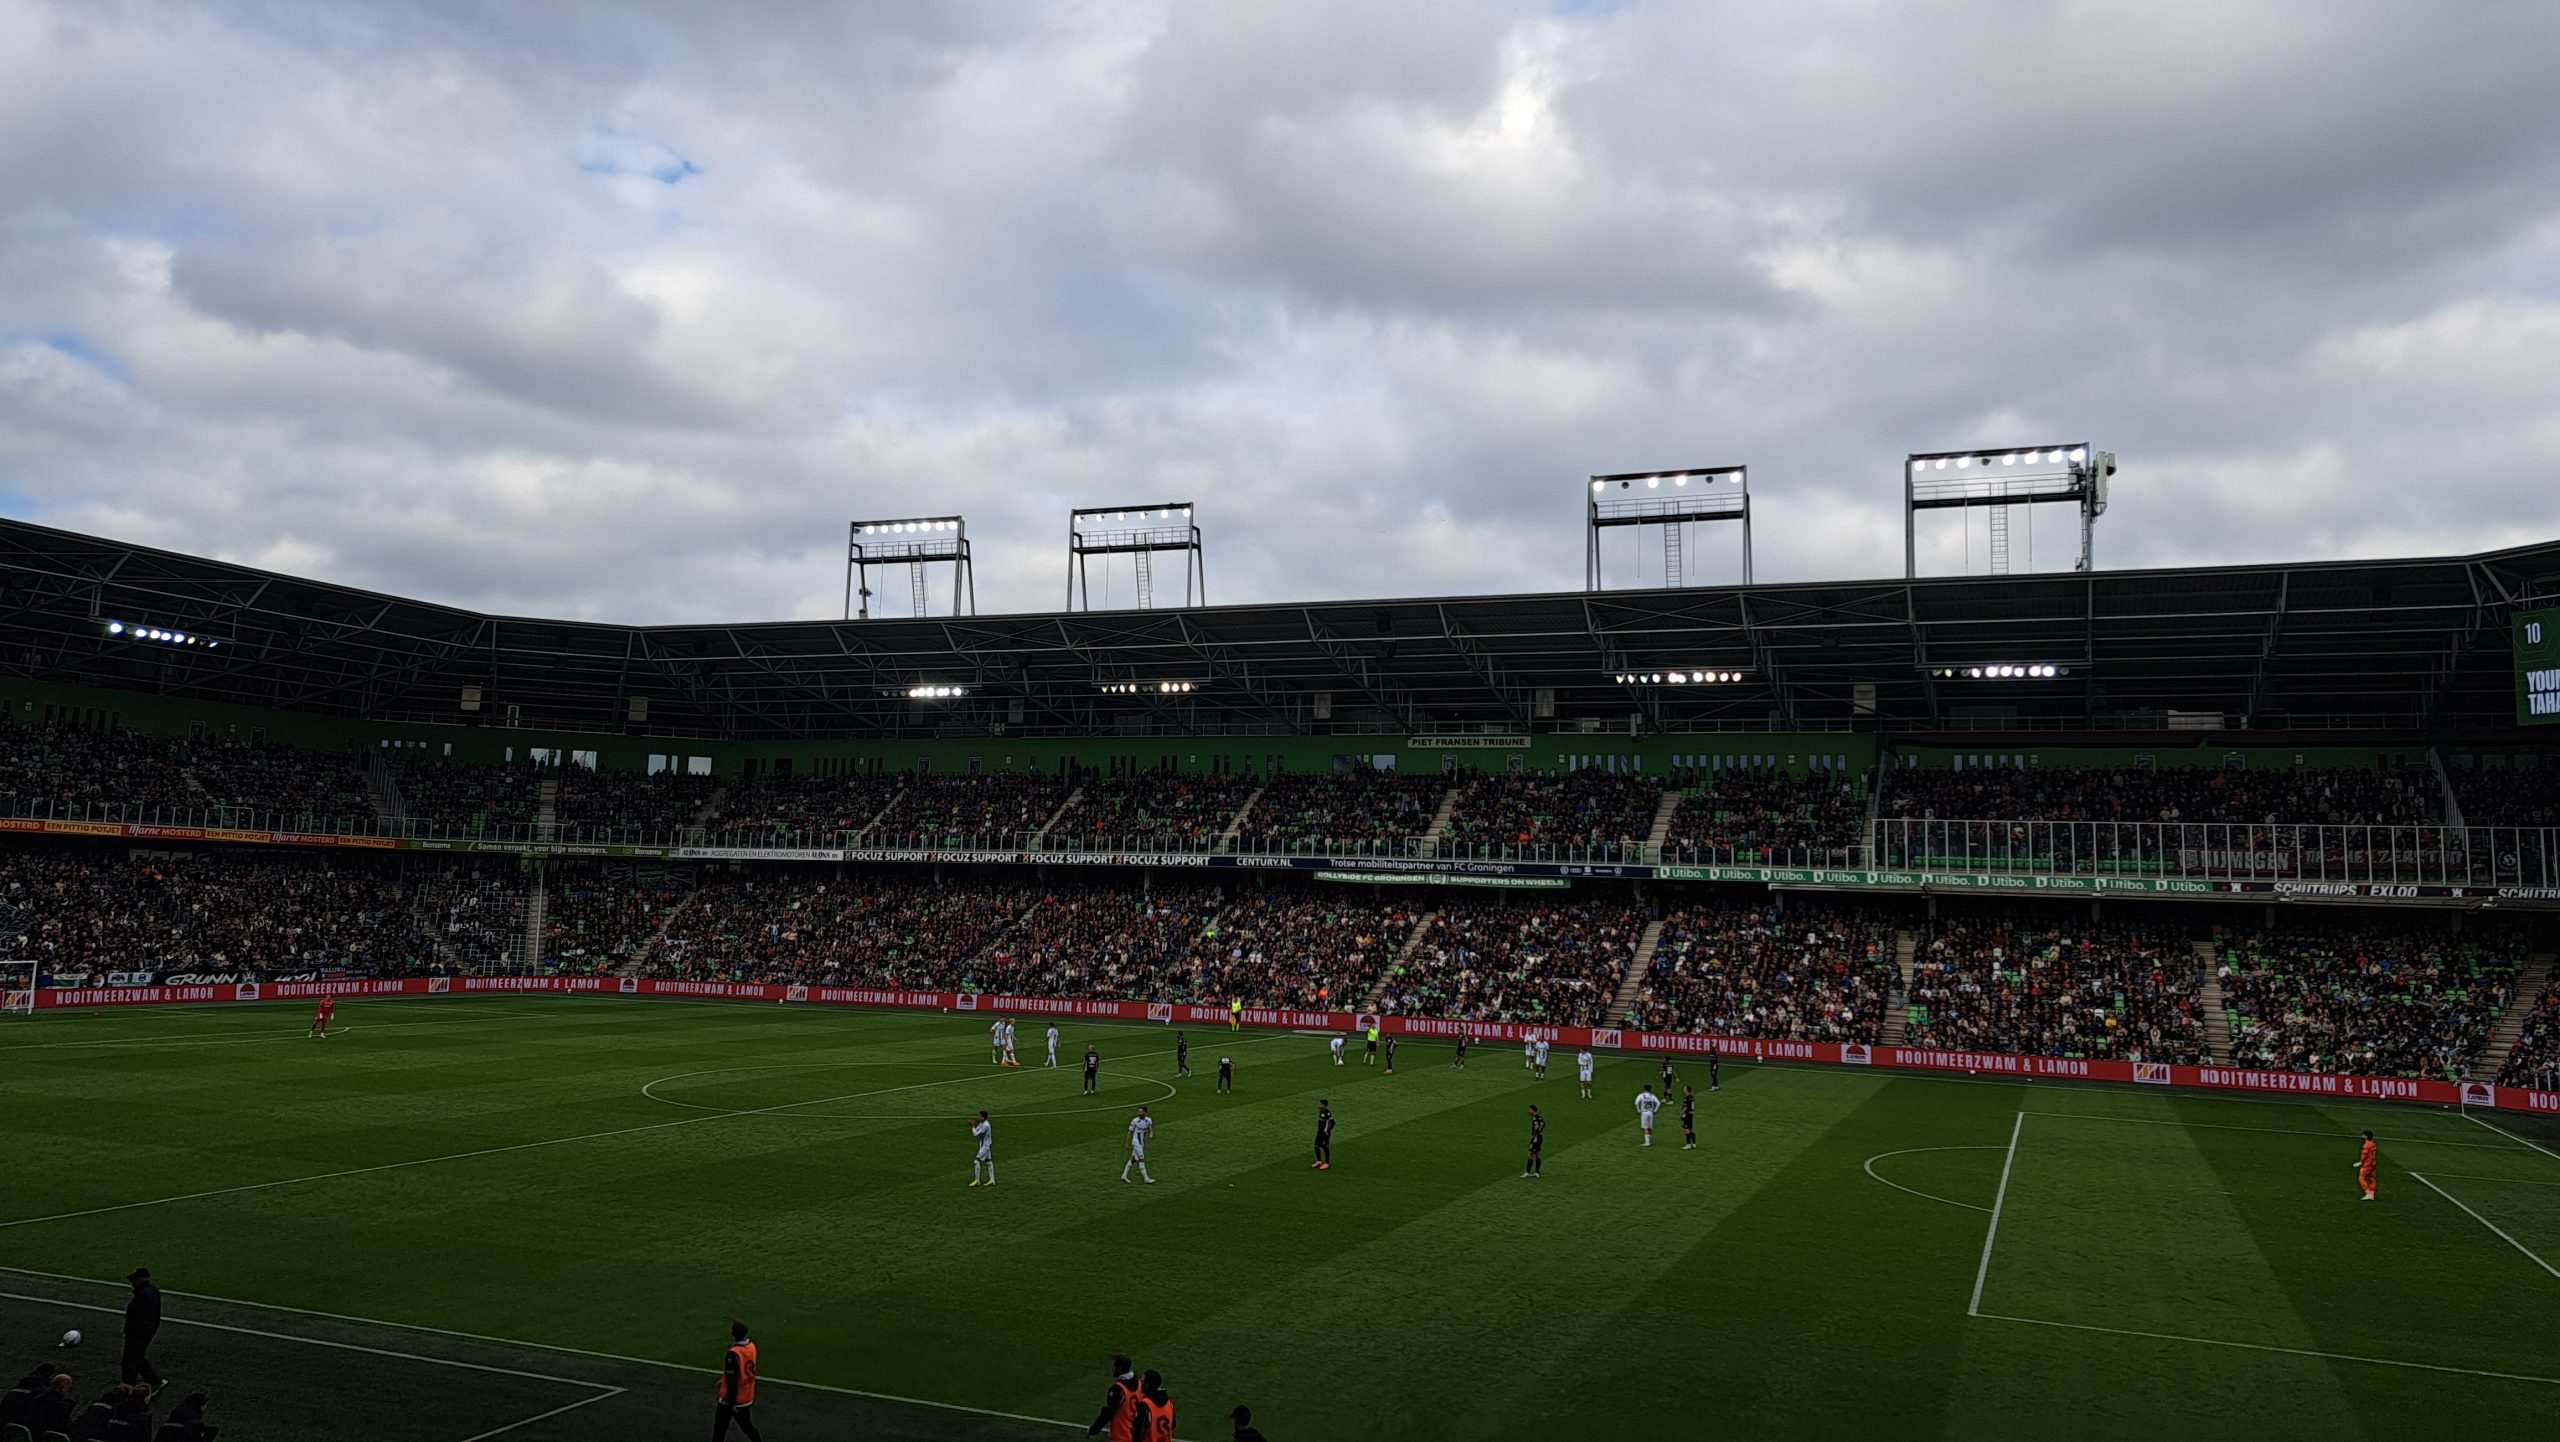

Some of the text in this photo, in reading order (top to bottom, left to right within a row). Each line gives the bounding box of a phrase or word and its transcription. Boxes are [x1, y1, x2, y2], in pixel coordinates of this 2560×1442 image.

[2524, 623, 2541, 644] 10
[128, 825, 202, 837] Marne MOSTERD
[300, 836, 335, 844] MOSTERD
[851, 851, 930, 862] FOCUZ SUPPORT
[937, 852, 1017, 863] FOCUZ SUPPORT
[1030, 853, 1113, 865] FOCUZ SUPPORT
[1123, 855, 1210, 866] FOCUZ SUPPORT
[1236, 857, 1293, 867] CENTURY.NL
[1330, 859, 1356, 868] Trotse
[1357, 860, 1434, 871] mobiliteitspartner
[1454, 863, 1466, 872] FC
[1467, 864, 1514, 875] Groningen
[1374, 873, 1425, 882] GRONINGEN
[1450, 876, 1509, 885] SUPPORTERS
[1511, 877, 1523, 885] ON
[1523, 877, 1565, 886] WHEELS
[1672, 868, 1703, 879] Utibo.
[1722, 870, 1754, 880] Utibo.
[1773, 871, 1806, 881] Utibo.
[1826, 872, 1860, 883] Utibo.
[1880, 873, 1915, 884] Utibo.
[1935, 874, 1971, 885] Utibo.
[1992, 876, 2028, 887] Utibo.
[2051, 877, 2087, 888] Utibo.
[2110, 879, 2147, 890] Utibo.
[2171, 880, 2209, 892] Utibo.
[2370, 885, 2418, 897] EXLOO
[165, 972, 239, 986] GRUNN
[465, 977, 600, 990] NOOITMEERZWAM & LAMON
[278, 980, 404, 996] NOOITMEERZWAM & LAMON
[655, 980, 764, 997] NOOITMEERZWAM & LAMON
[56, 987, 214, 1004] NOOITMEERZWAM & LAMON
[821, 989, 938, 1006] NOOITMEERZWAM & LAMON
[992, 998, 1119, 1015] NOOITMEERZWAM & LAMON
[1282, 1013, 1288, 1024] &
[1293, 1013, 1328, 1027] LAMON
[1507, 1025, 1514, 1038] &
[1754, 1043, 1763, 1055] &
[1768, 1043, 1813, 1058] LAMON
[1896, 1050, 2088, 1076] NOOITMEERZWAM & LAMON
[2200, 1068, 2418, 1097] NOOITMEERZWAM & LAMON
[2529, 1092, 2560, 1111] NOO
